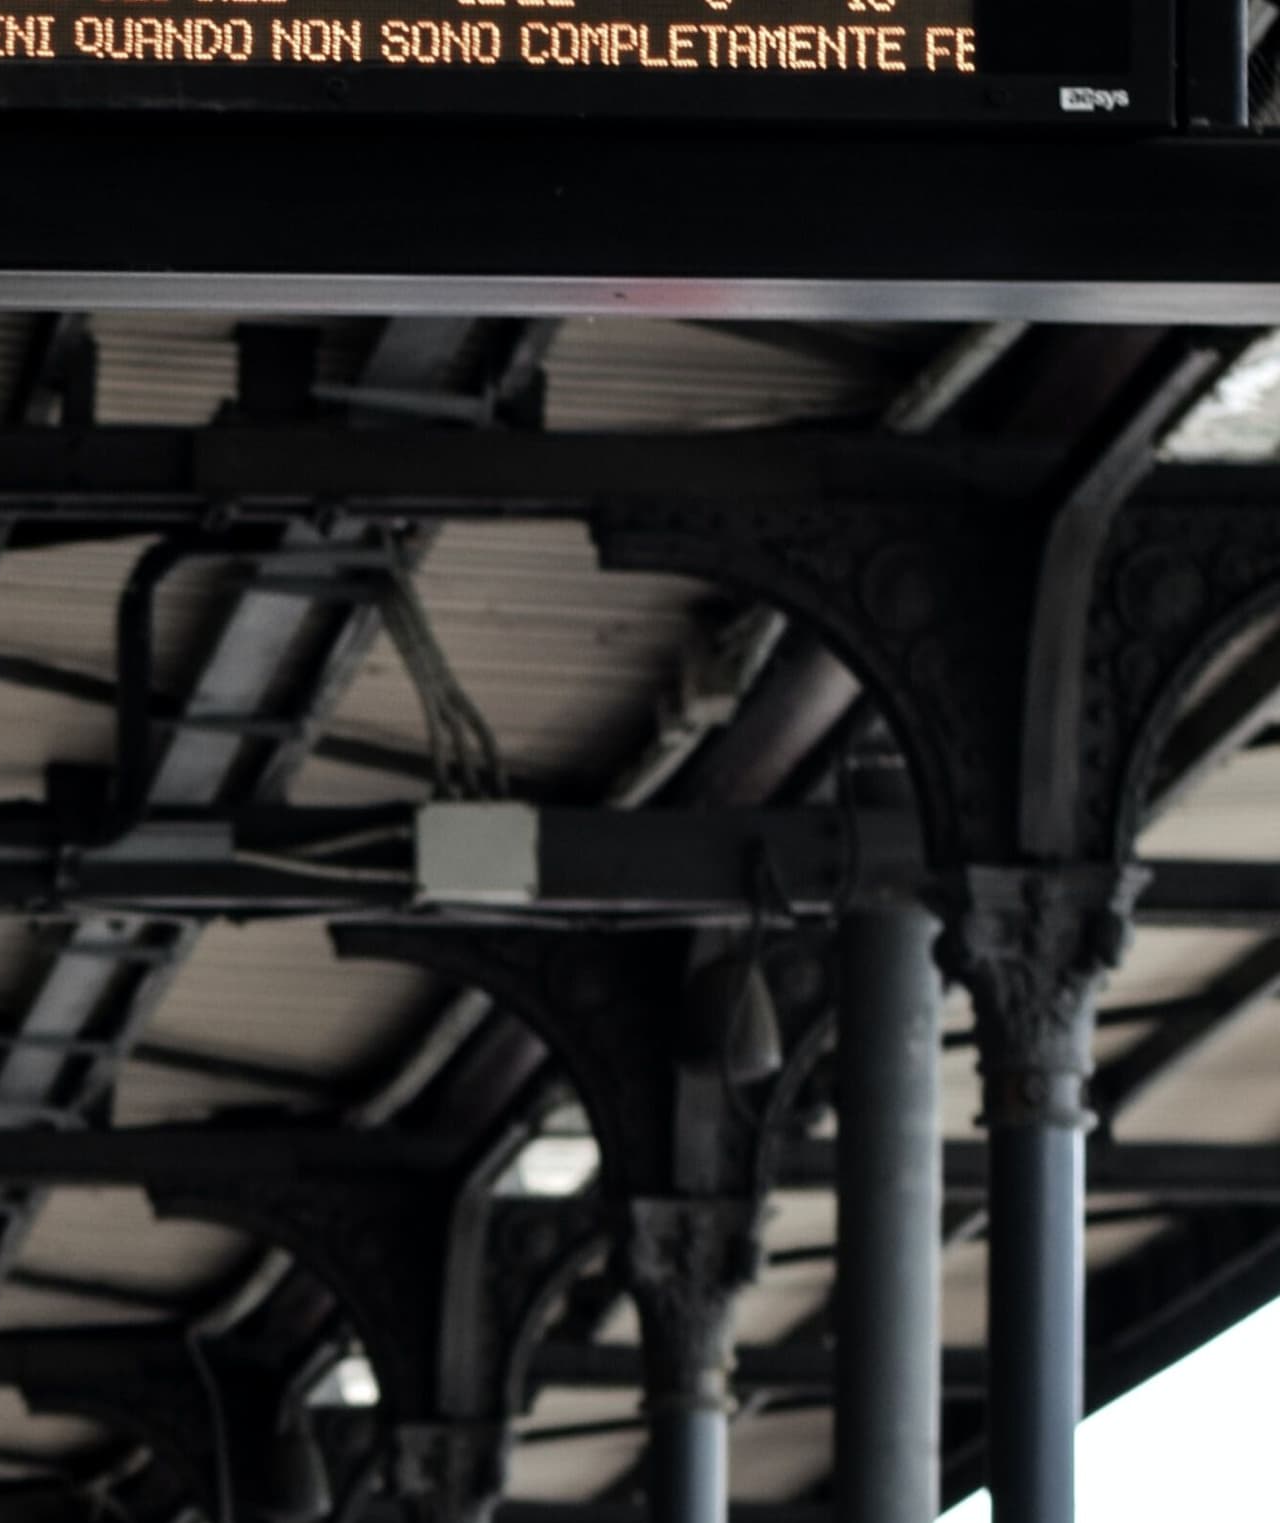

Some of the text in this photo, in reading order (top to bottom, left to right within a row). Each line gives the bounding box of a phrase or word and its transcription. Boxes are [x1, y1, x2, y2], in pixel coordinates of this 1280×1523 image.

[74, 16, 253, 61] QUANDO
[271, 18, 362, 62] NON
[381, 20, 501, 64] SONO
[520, 22, 906, 72] COMPLETAMENTE
[925, 26, 976, 73] FE
